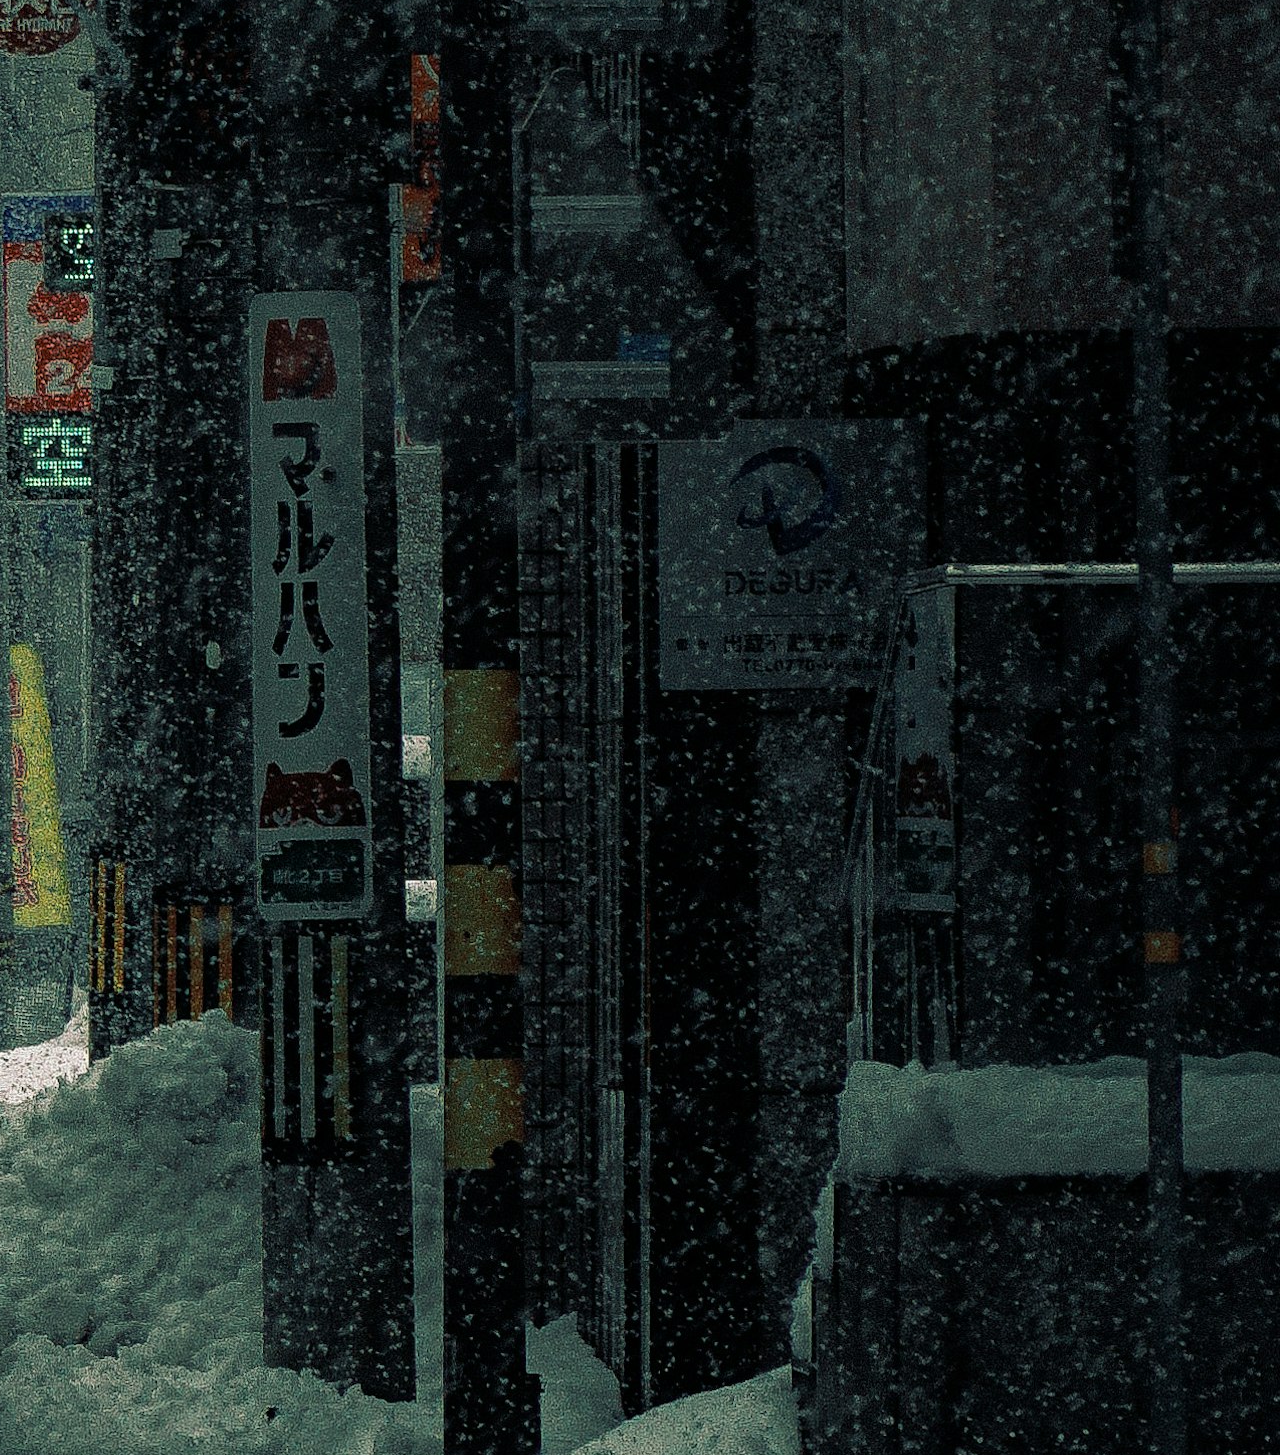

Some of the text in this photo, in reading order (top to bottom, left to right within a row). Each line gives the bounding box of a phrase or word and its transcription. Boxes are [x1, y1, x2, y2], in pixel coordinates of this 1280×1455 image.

[21, 418, 93, 486] 空
[270, 422, 335, 740] マルハン
